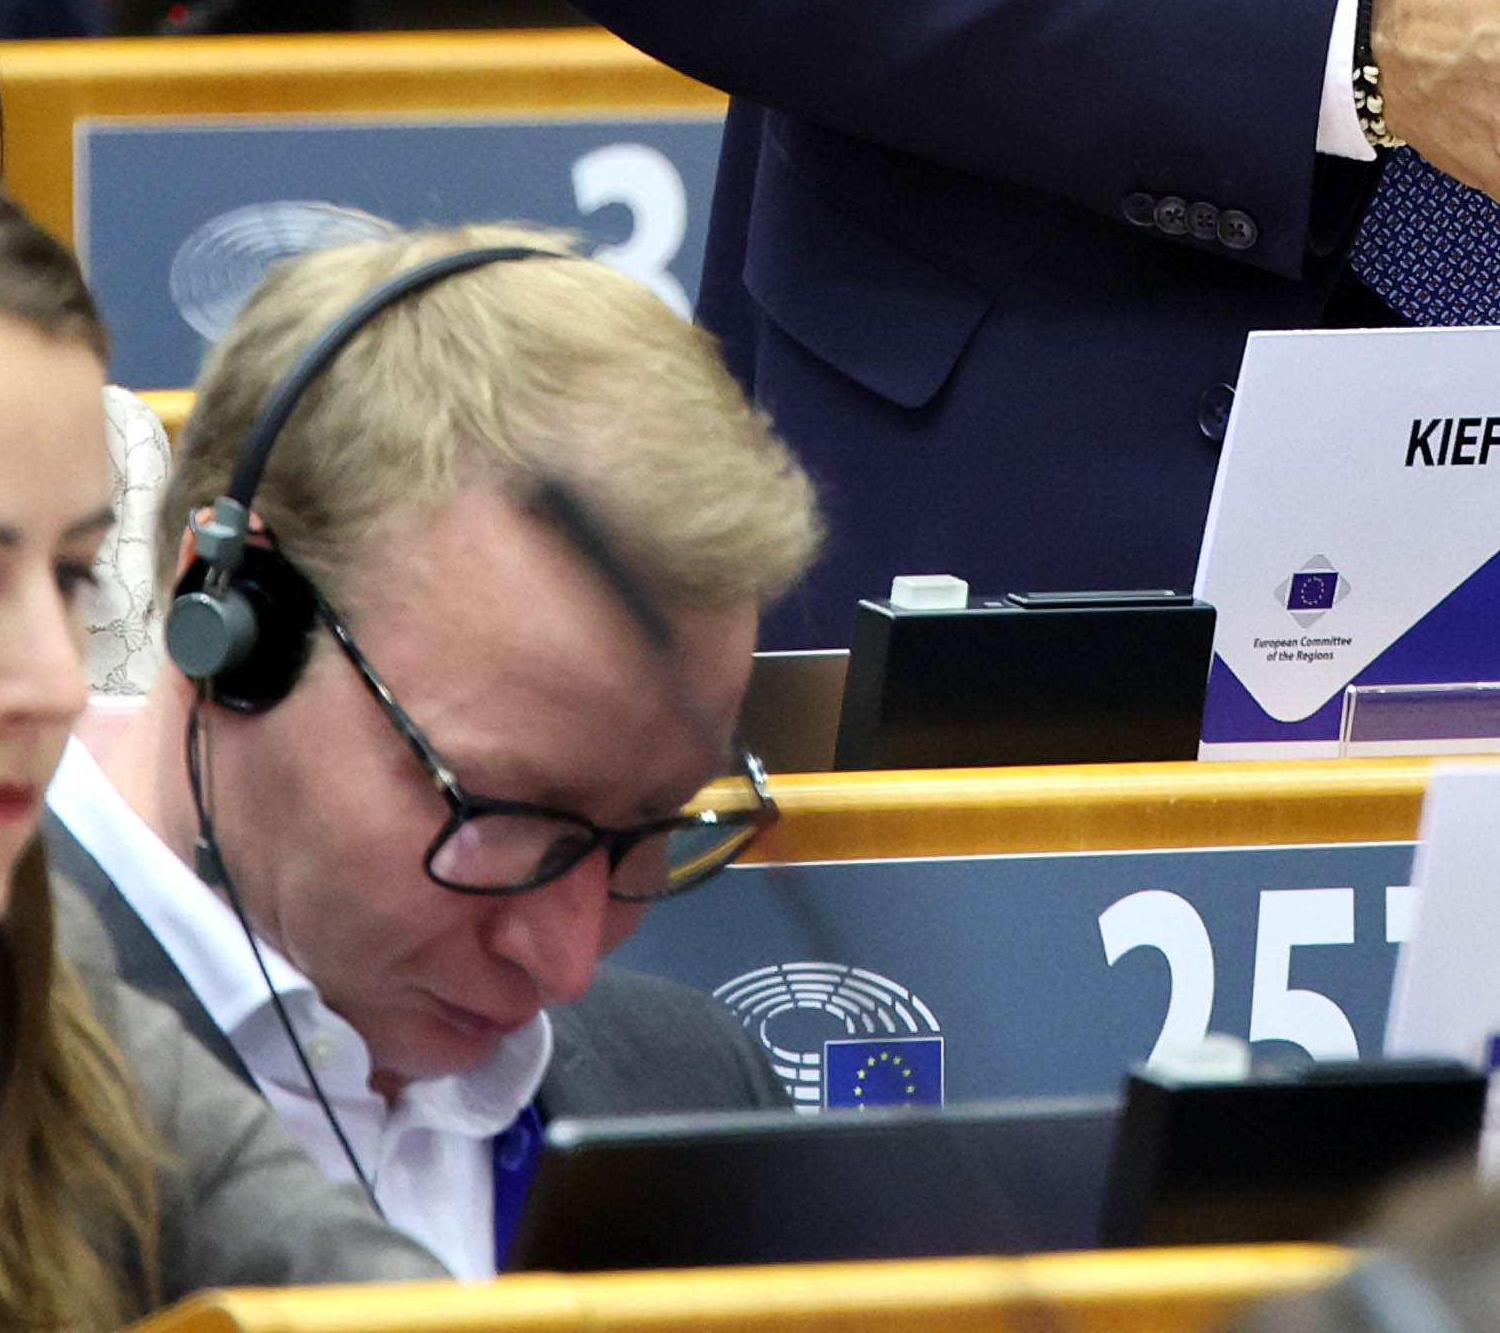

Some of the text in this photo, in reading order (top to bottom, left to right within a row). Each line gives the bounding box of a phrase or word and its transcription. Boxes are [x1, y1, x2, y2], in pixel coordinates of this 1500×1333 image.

[1253, 636, 1352, 649] European Committee
[1266, 649, 1334, 663] of the Regions
[1098, 887, 1419, 1071] 25
